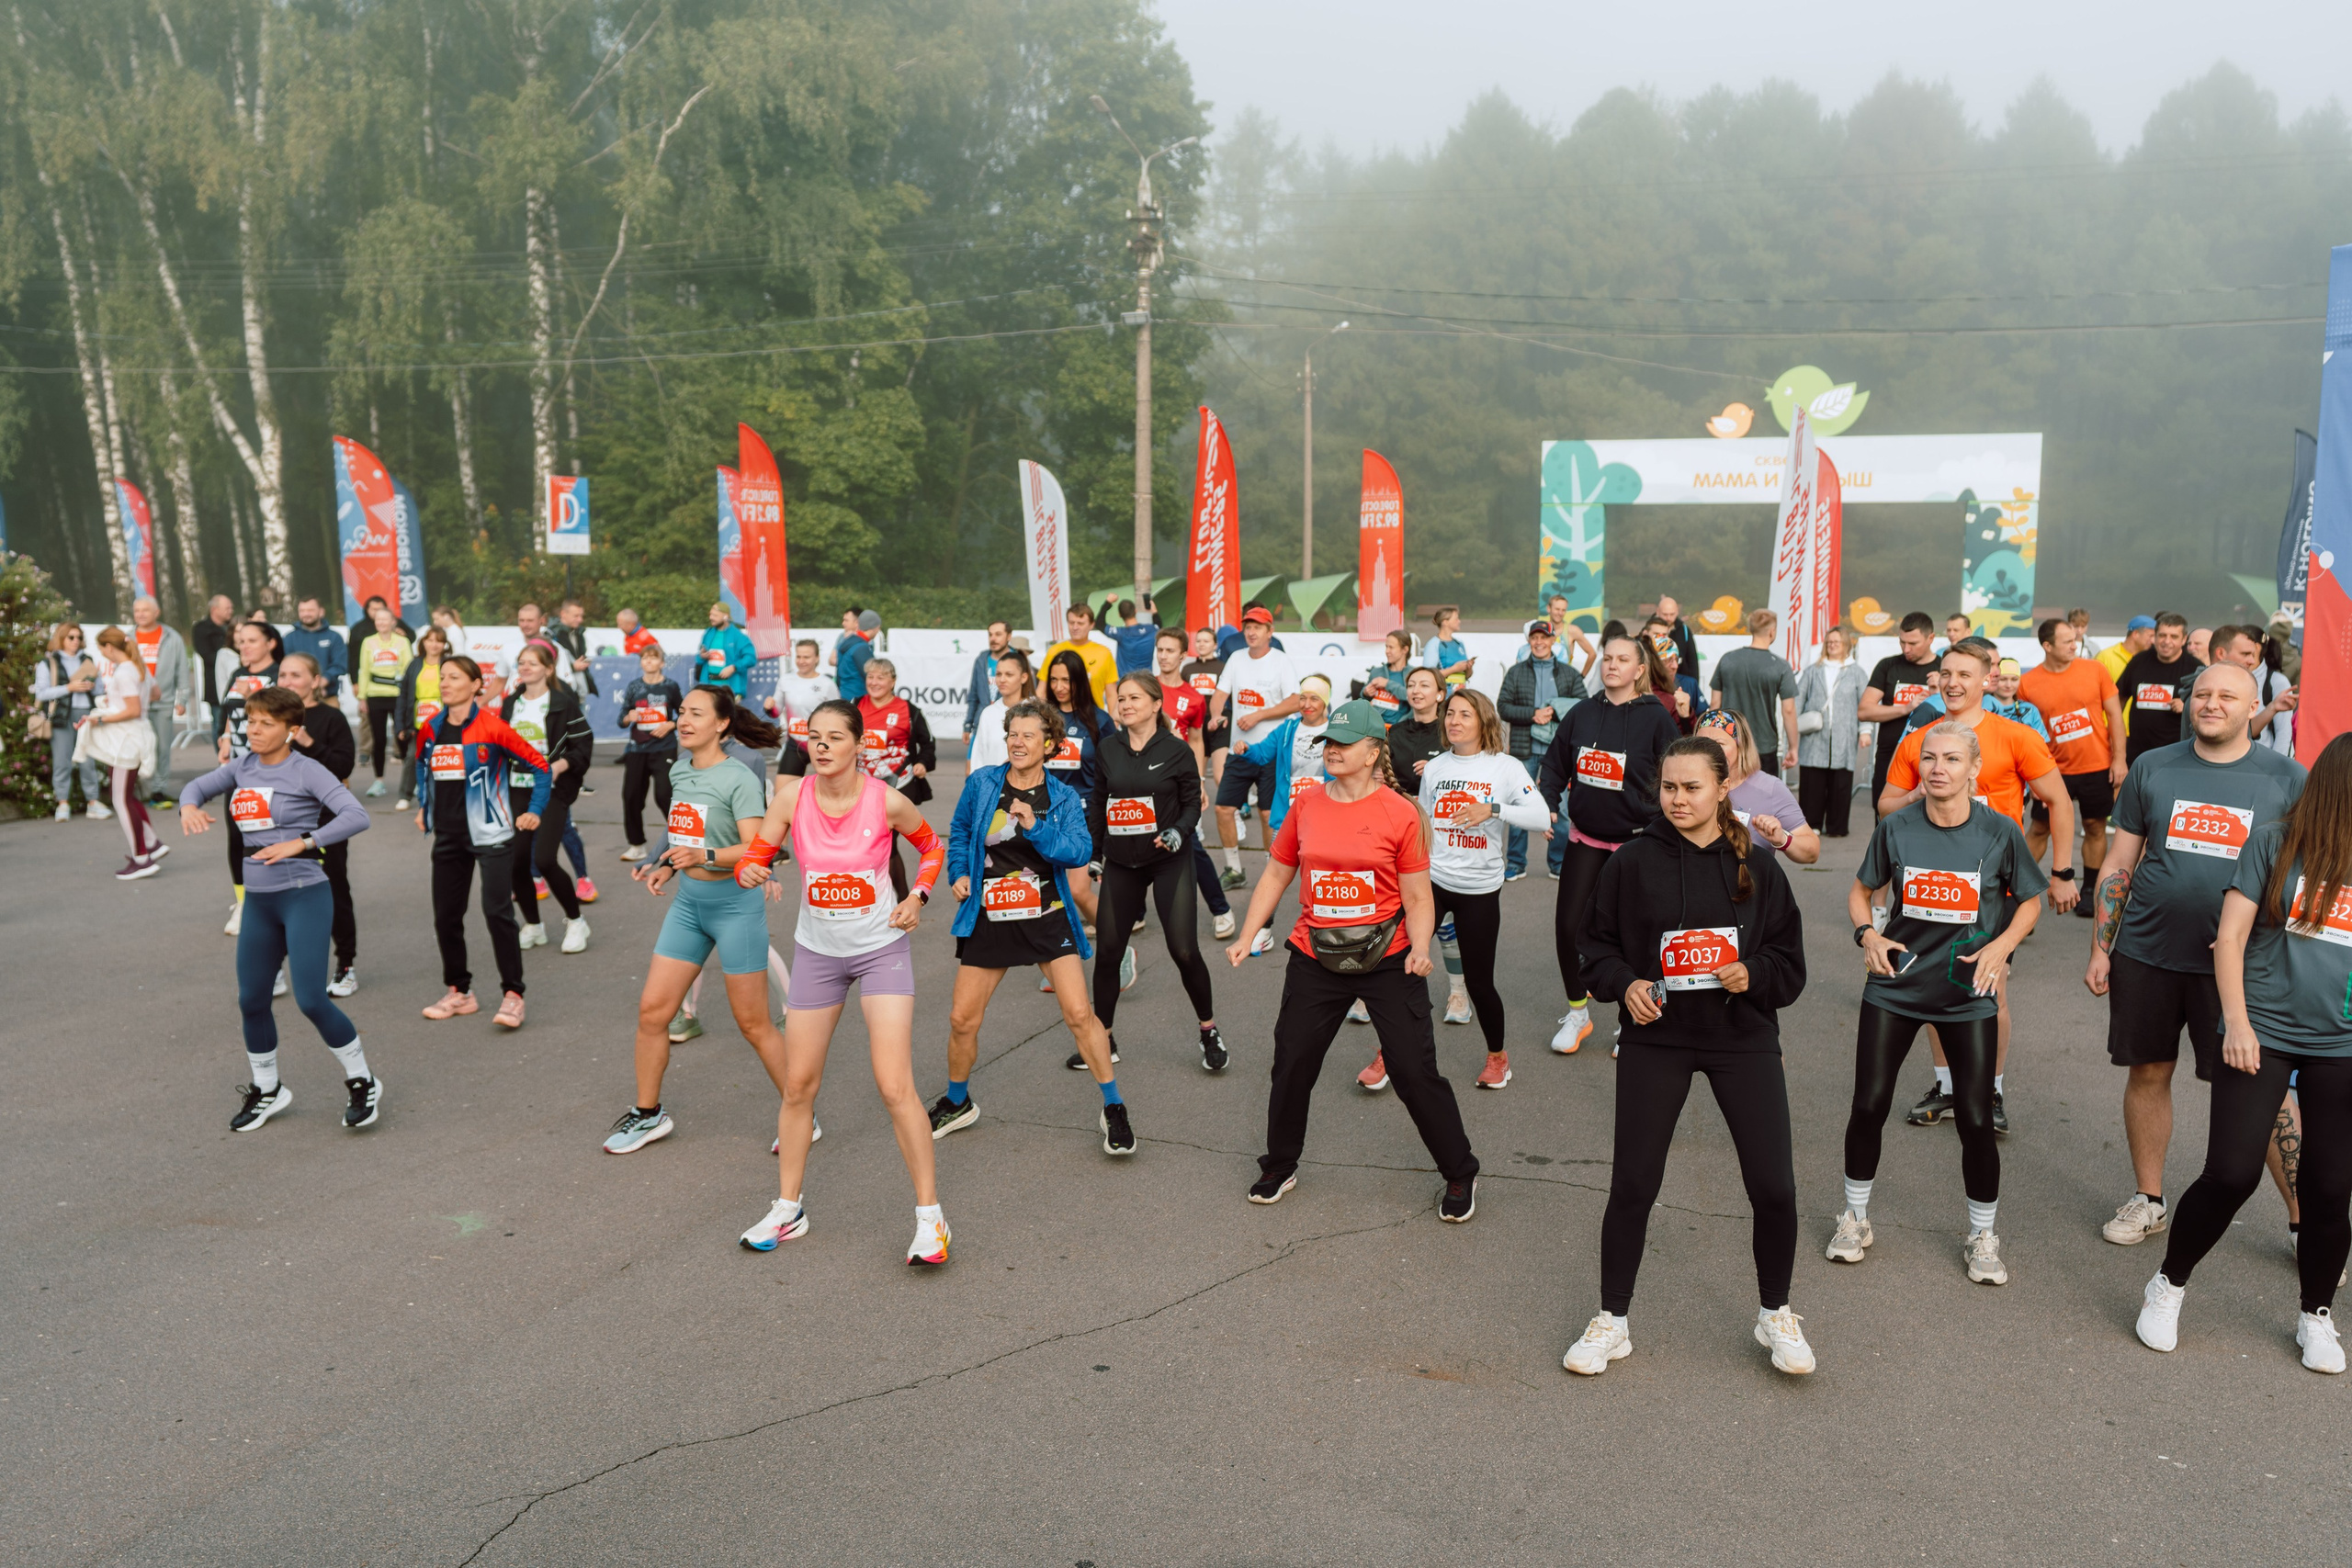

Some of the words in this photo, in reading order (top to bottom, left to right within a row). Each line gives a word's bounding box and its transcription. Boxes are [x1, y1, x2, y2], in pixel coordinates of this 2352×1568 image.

[1755, 456, 1787, 466] СКВ
[1693, 472, 1758, 488] МАМА
[1764, 472, 1779, 488] И
[559, 491, 581, 530] D
[898, 686, 968, 705] ОКОМ
[2062, 718, 2081, 732] 2121
[436, 754, 460, 766] 2246
[1588, 760, 1612, 774] 2013
[236, 800, 259, 815] 2015
[1115, 808, 1144, 820] 2206
[673, 814, 695, 829] 2105
[2177, 819, 2185, 828] D
[2188, 818, 2231, 837] 2332
[1456, 833, 1487, 850] ТОБОЙ
[820, 886, 861, 901] 2008
[996, 889, 1025, 904] 2189
[1325, 886, 1359, 899] 2180
[1909, 886, 1917, 896] D
[1920, 885, 1962, 902] 2330
[1667, 954, 1674, 964] D
[1679, 946, 1722, 965] 2037
